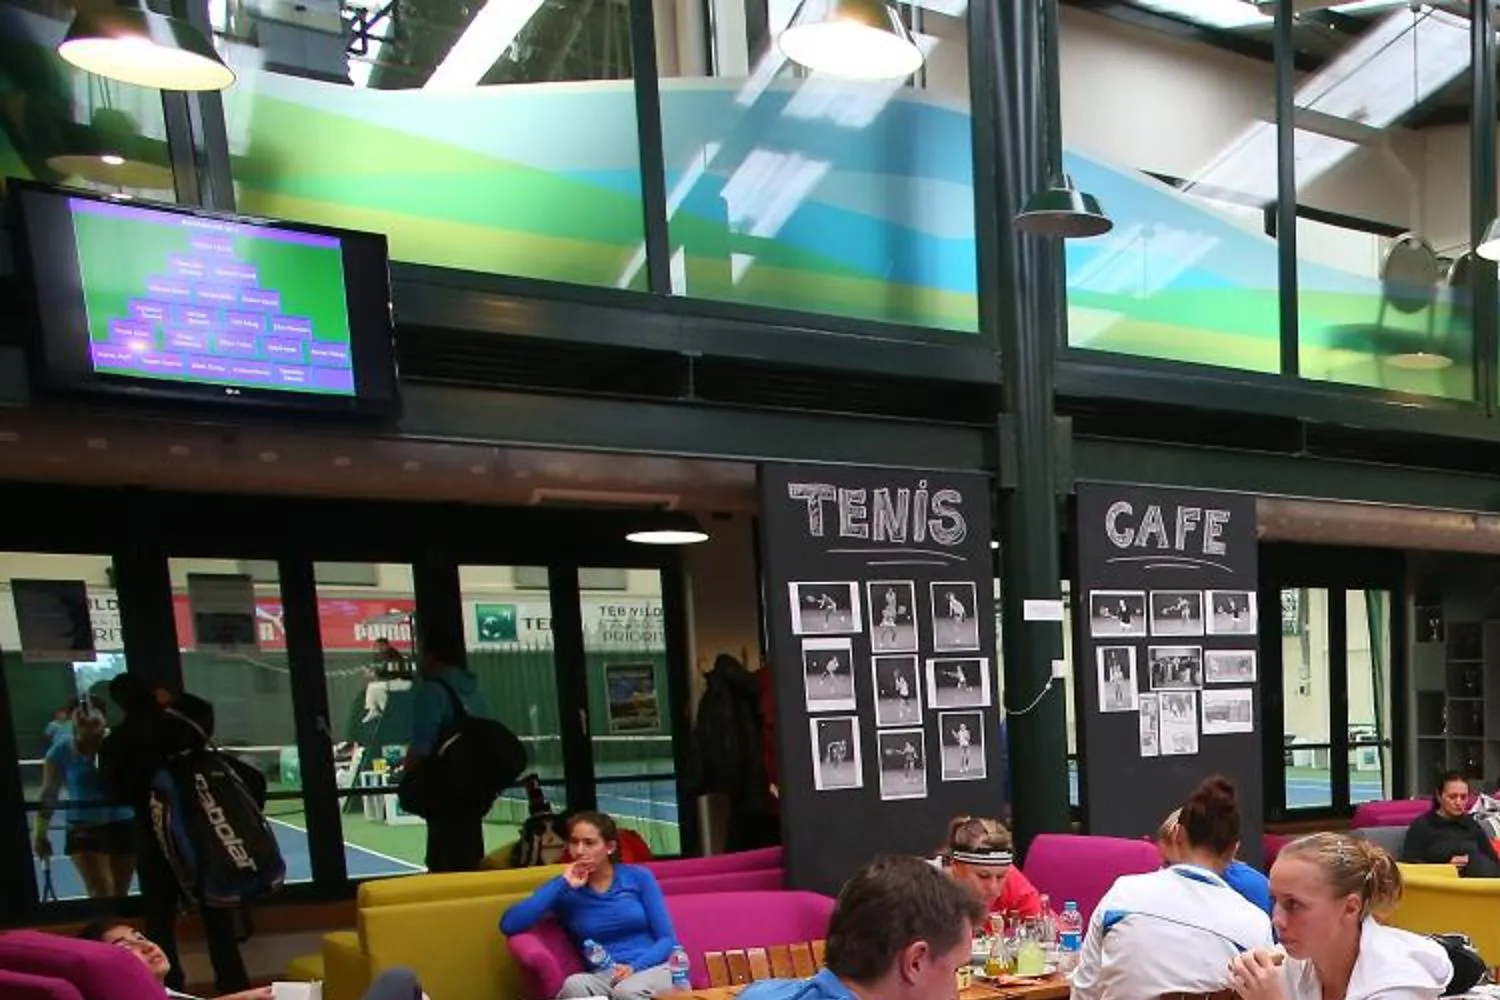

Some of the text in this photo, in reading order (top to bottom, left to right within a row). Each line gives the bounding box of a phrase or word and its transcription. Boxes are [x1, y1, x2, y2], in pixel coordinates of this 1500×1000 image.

[788, 480, 968, 546] TENİS
[1104, 500, 1232, 556] CAFE
[520, 617, 551, 631] TE
